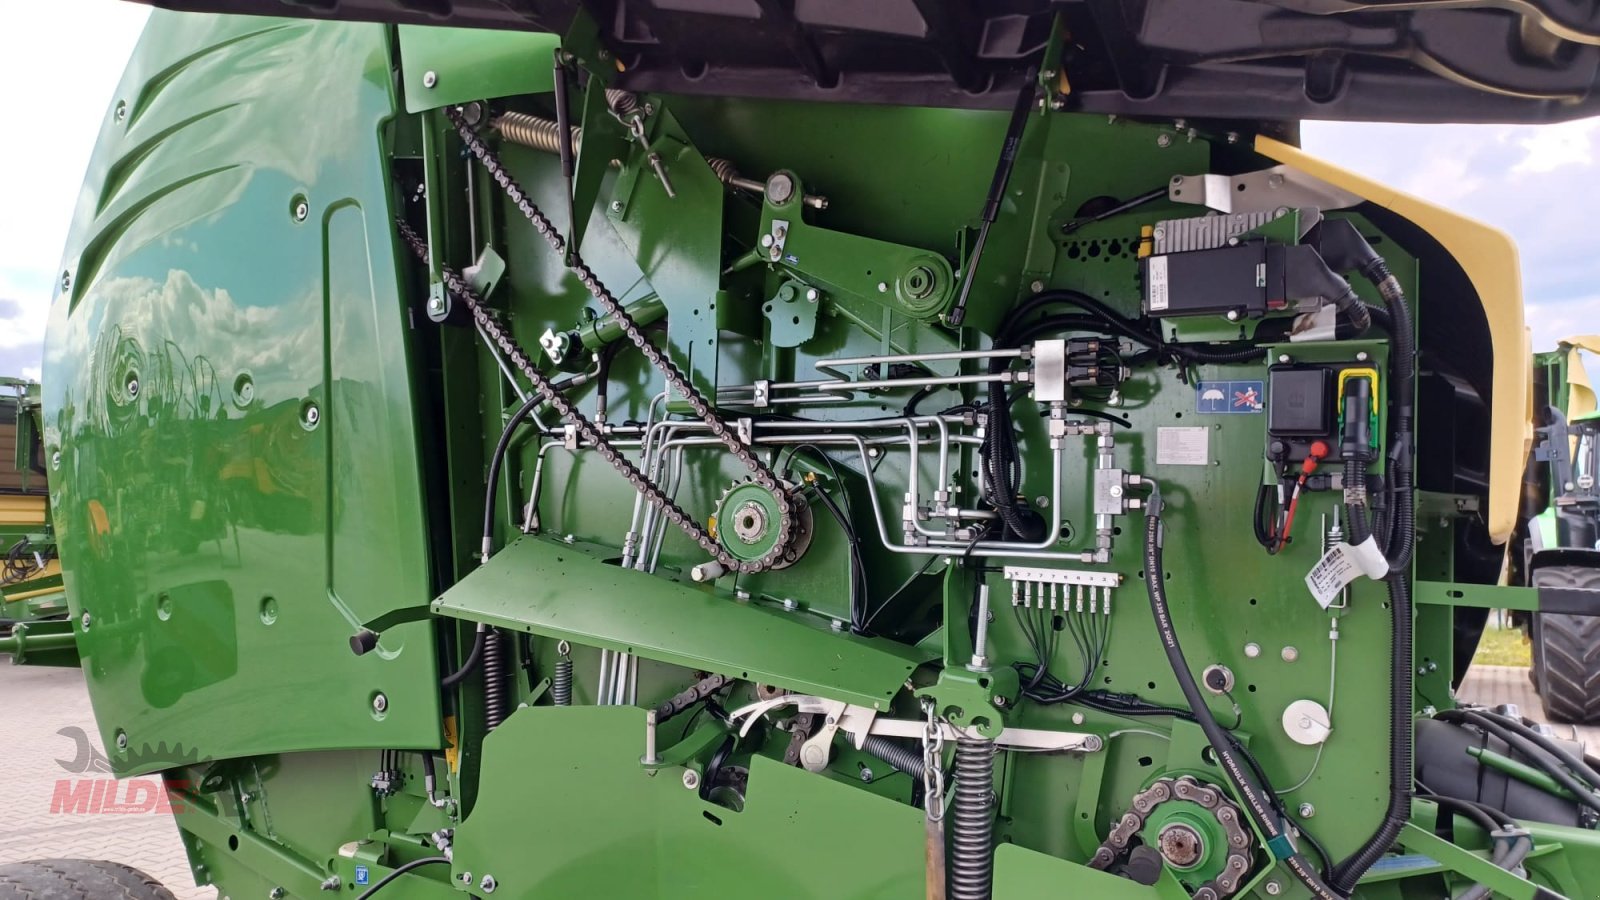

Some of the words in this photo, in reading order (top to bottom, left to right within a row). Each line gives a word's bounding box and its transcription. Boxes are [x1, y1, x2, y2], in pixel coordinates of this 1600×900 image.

[1154, 591, 1161, 602] WP
[1159, 614, 1168, 628] BAR
[1222, 750, 1247, 786] HYDRAULIK
[1243, 785, 1264, 814] MUELLER
